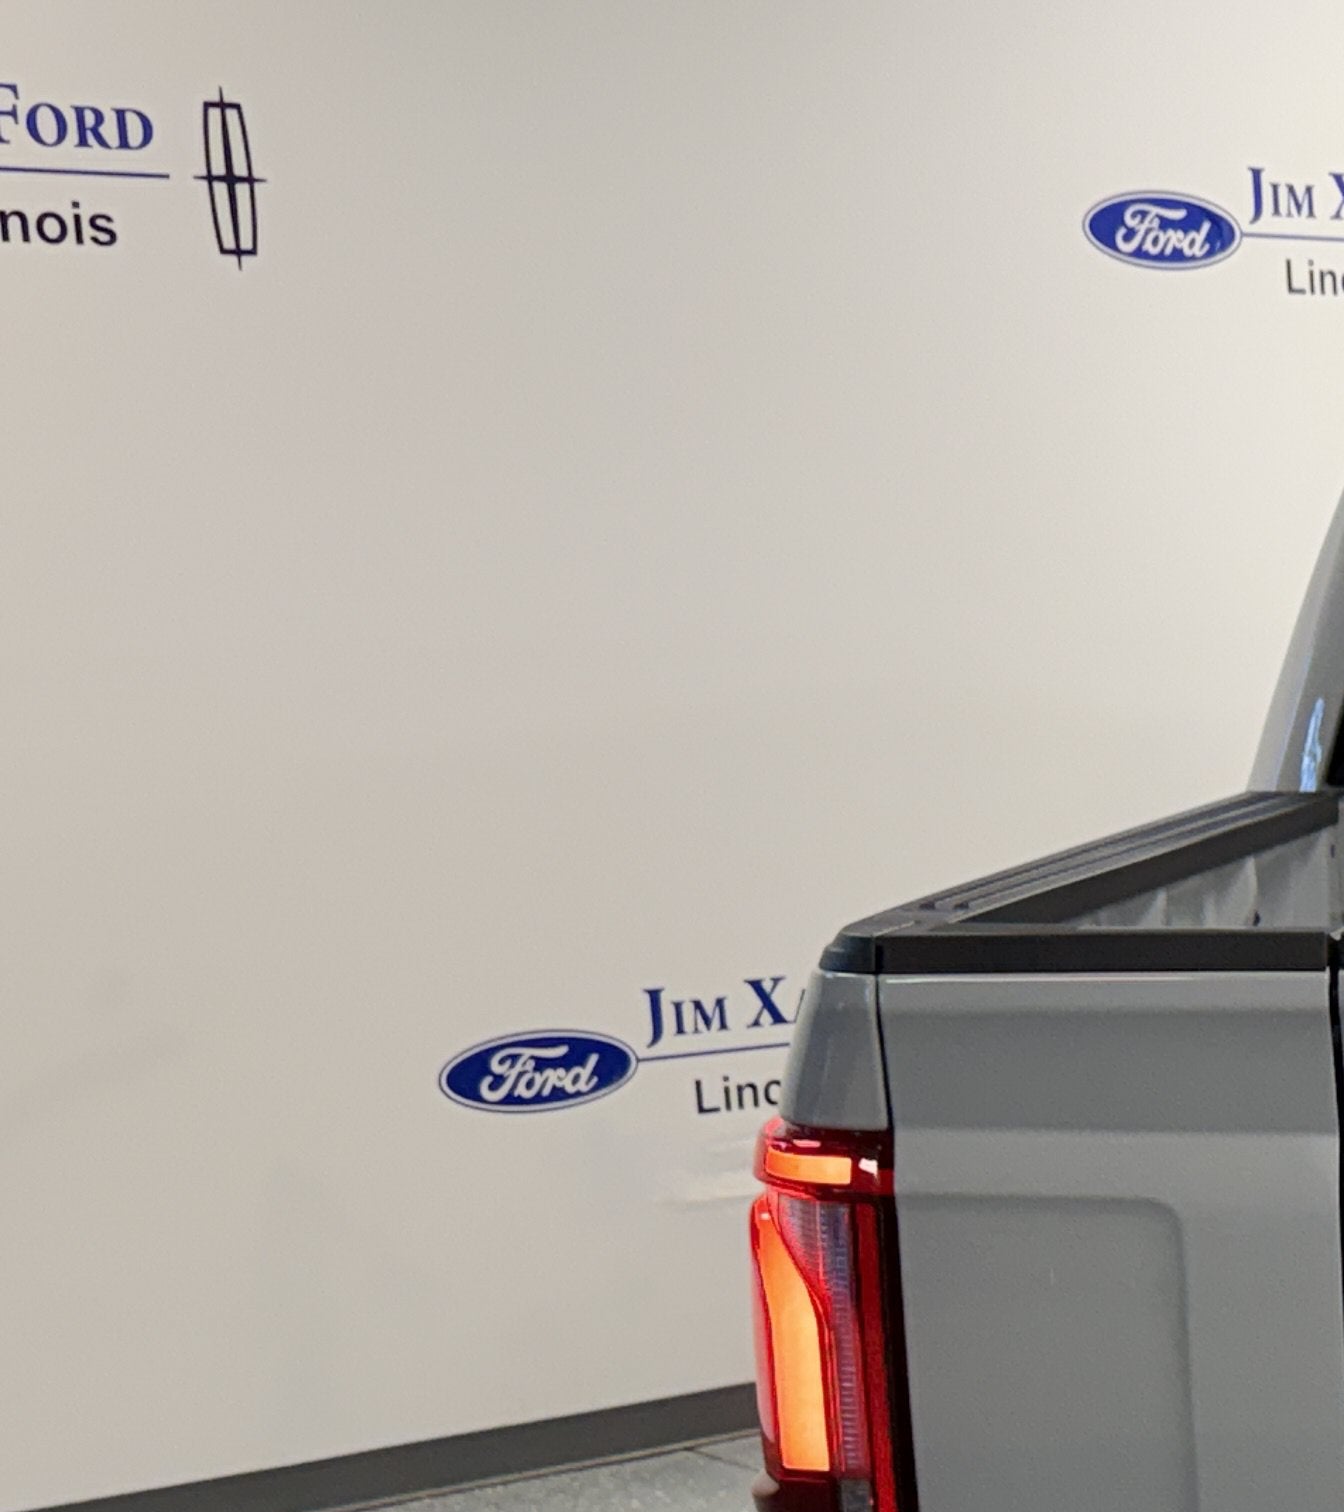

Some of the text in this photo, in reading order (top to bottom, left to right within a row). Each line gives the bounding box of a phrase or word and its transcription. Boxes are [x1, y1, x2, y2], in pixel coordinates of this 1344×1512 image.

[1247, 167, 1317, 225] JIM
[1114, 204, 1211, 258] Ford
[643, 987, 730, 1049] JIM
[479, 1043, 600, 1103] Ford
